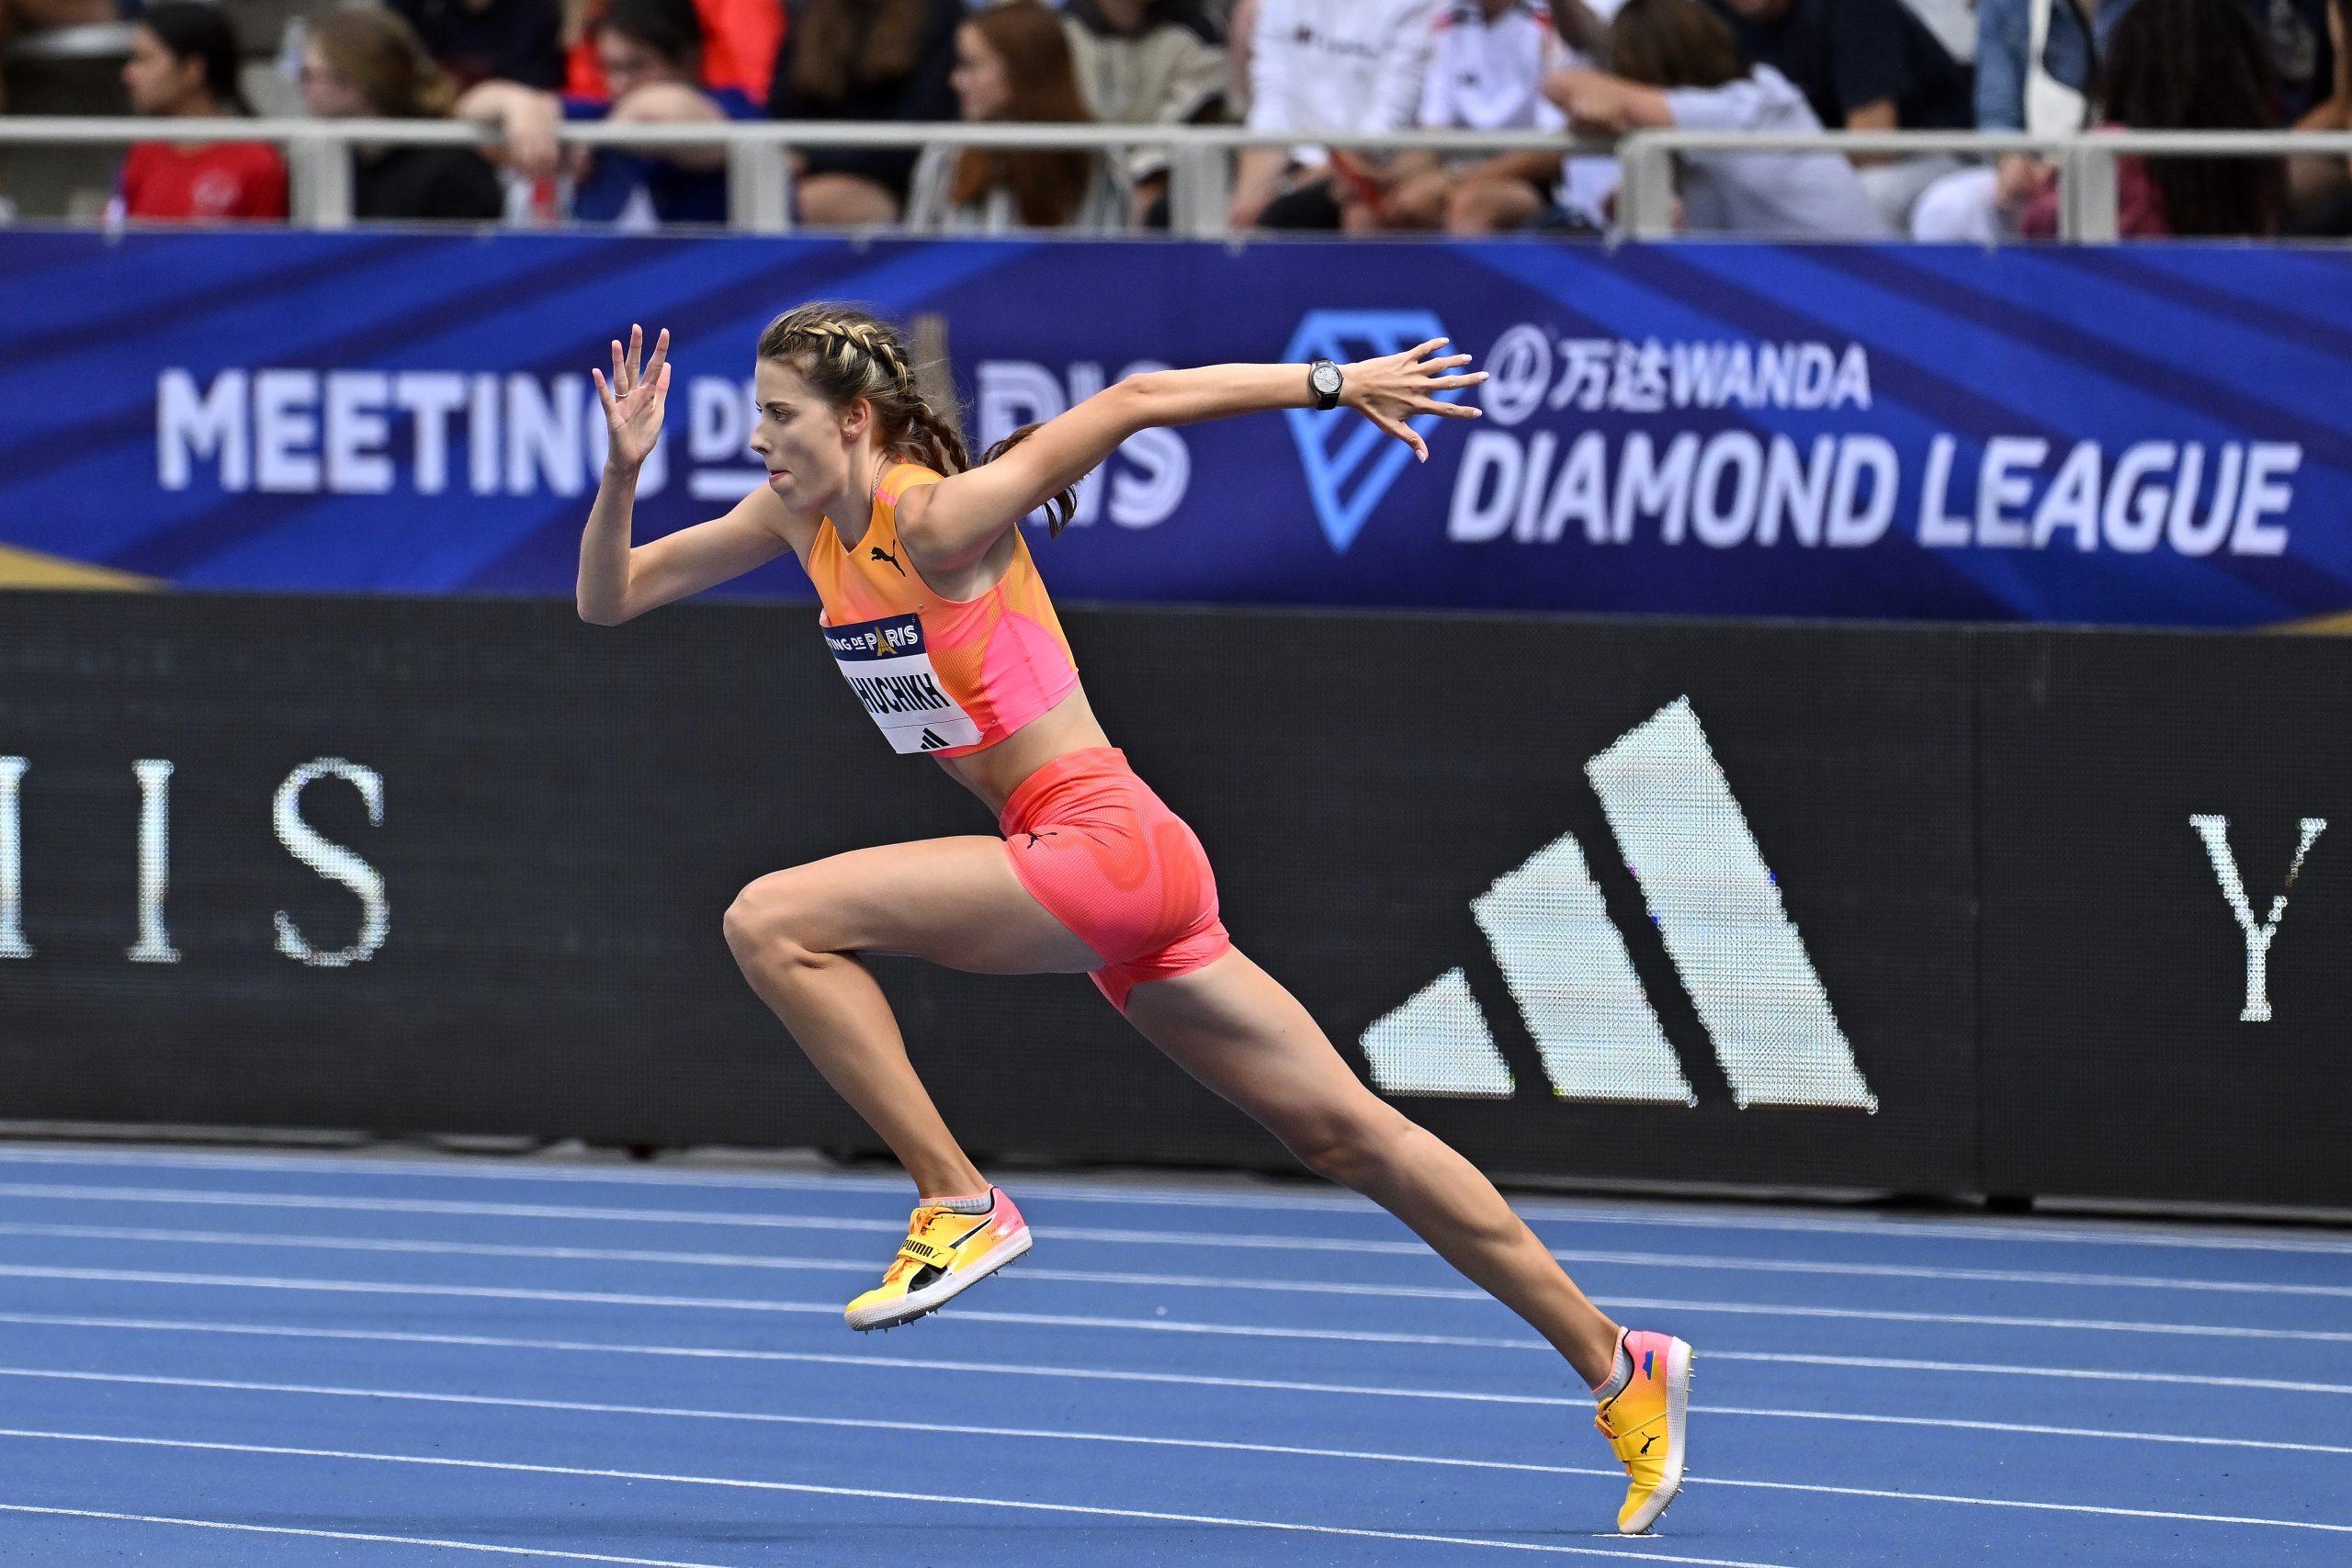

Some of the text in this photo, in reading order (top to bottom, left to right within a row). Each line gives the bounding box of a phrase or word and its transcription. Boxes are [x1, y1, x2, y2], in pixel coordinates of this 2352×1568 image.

[1669, 340, 1872, 412] WANDA
[1448, 429, 2303, 557] DIAMOND LEAGUE
[850, 637, 865, 647] DE
[844, 672, 952, 715] HUCHIKH
[900, 1239, 934, 1258] PUMA
